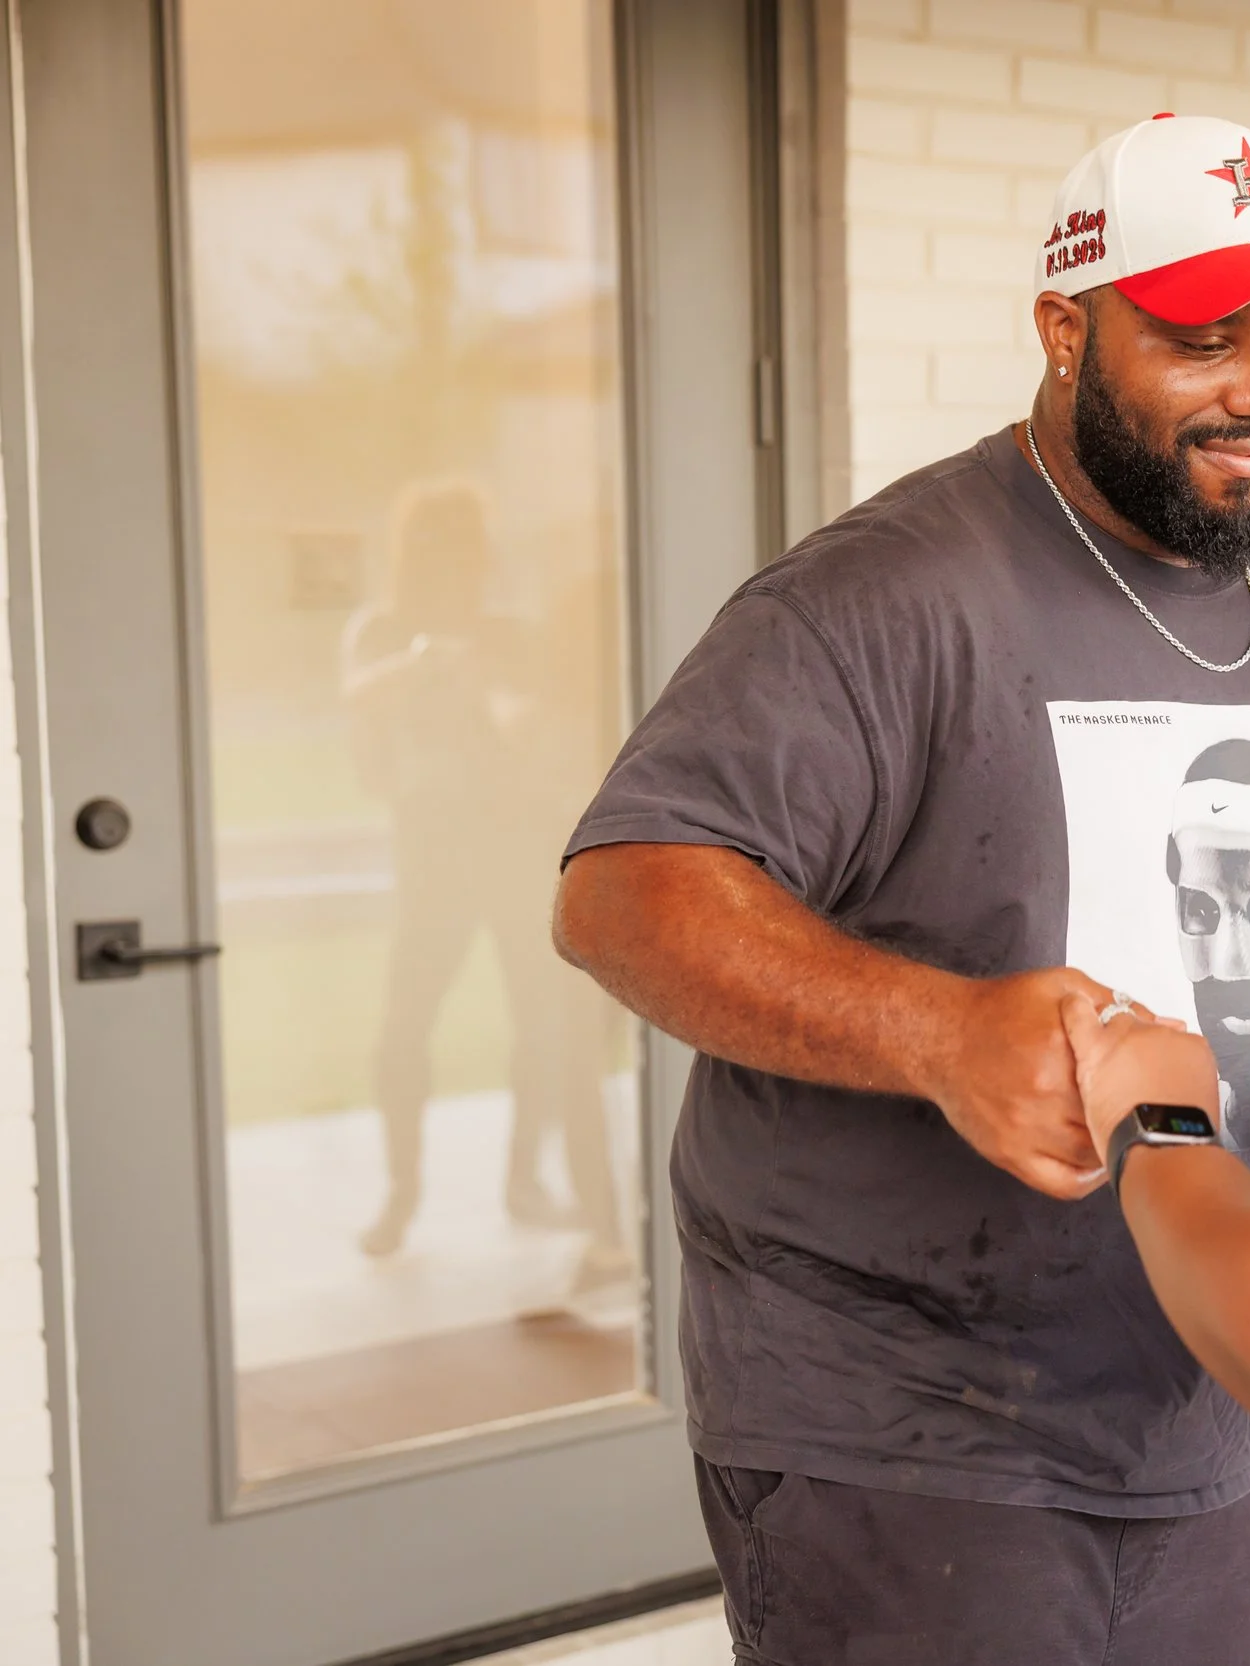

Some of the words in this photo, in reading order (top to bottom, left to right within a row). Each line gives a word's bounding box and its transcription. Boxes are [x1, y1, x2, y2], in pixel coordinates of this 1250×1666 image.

[1059, 714, 1081, 725] THE
[1083, 714, 1129, 725] MASKED
[1130, 715, 1172, 725] MENACE
